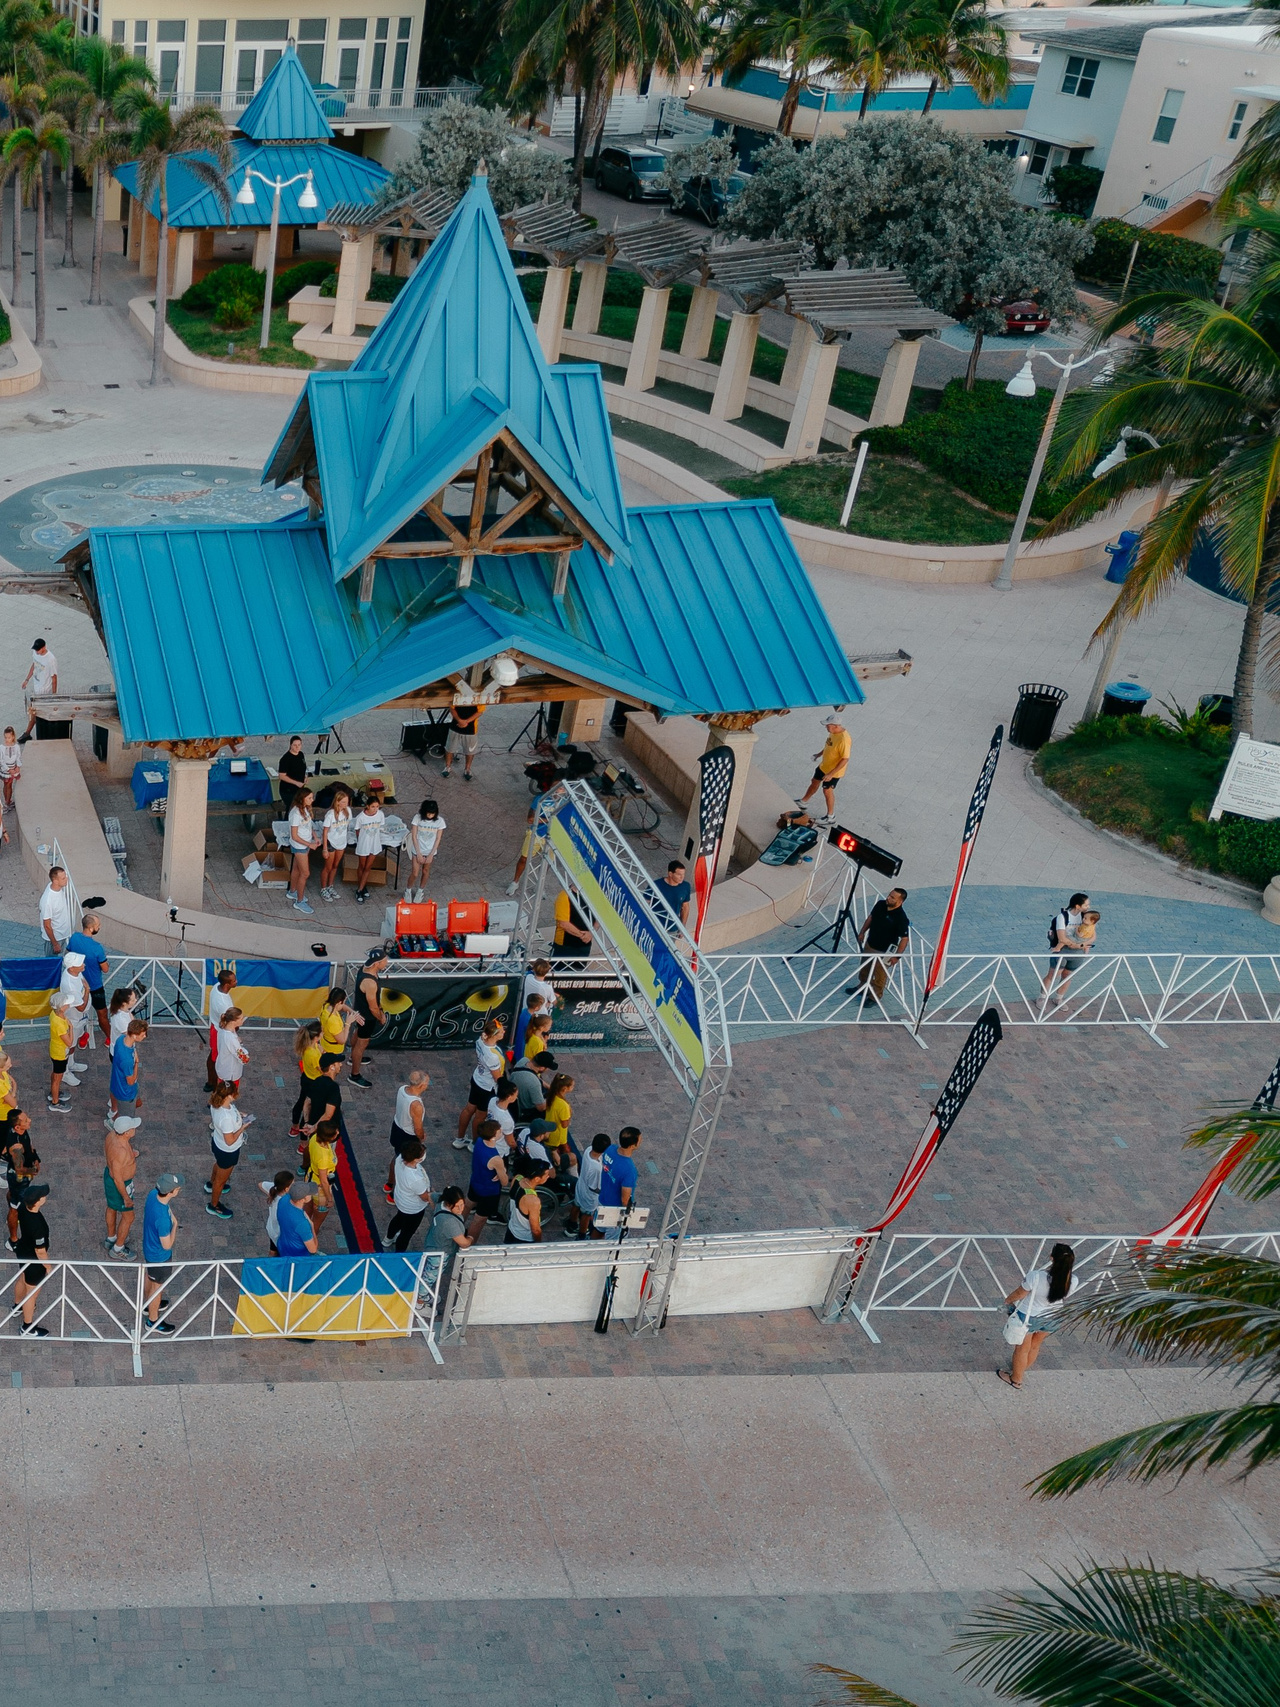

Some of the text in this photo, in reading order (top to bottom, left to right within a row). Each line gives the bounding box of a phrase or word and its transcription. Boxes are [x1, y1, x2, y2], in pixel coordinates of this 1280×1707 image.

[638, 927, 655, 963] RUN
[558, 980, 572, 988] FIRST
[573, 1001, 601, 1016] Split
